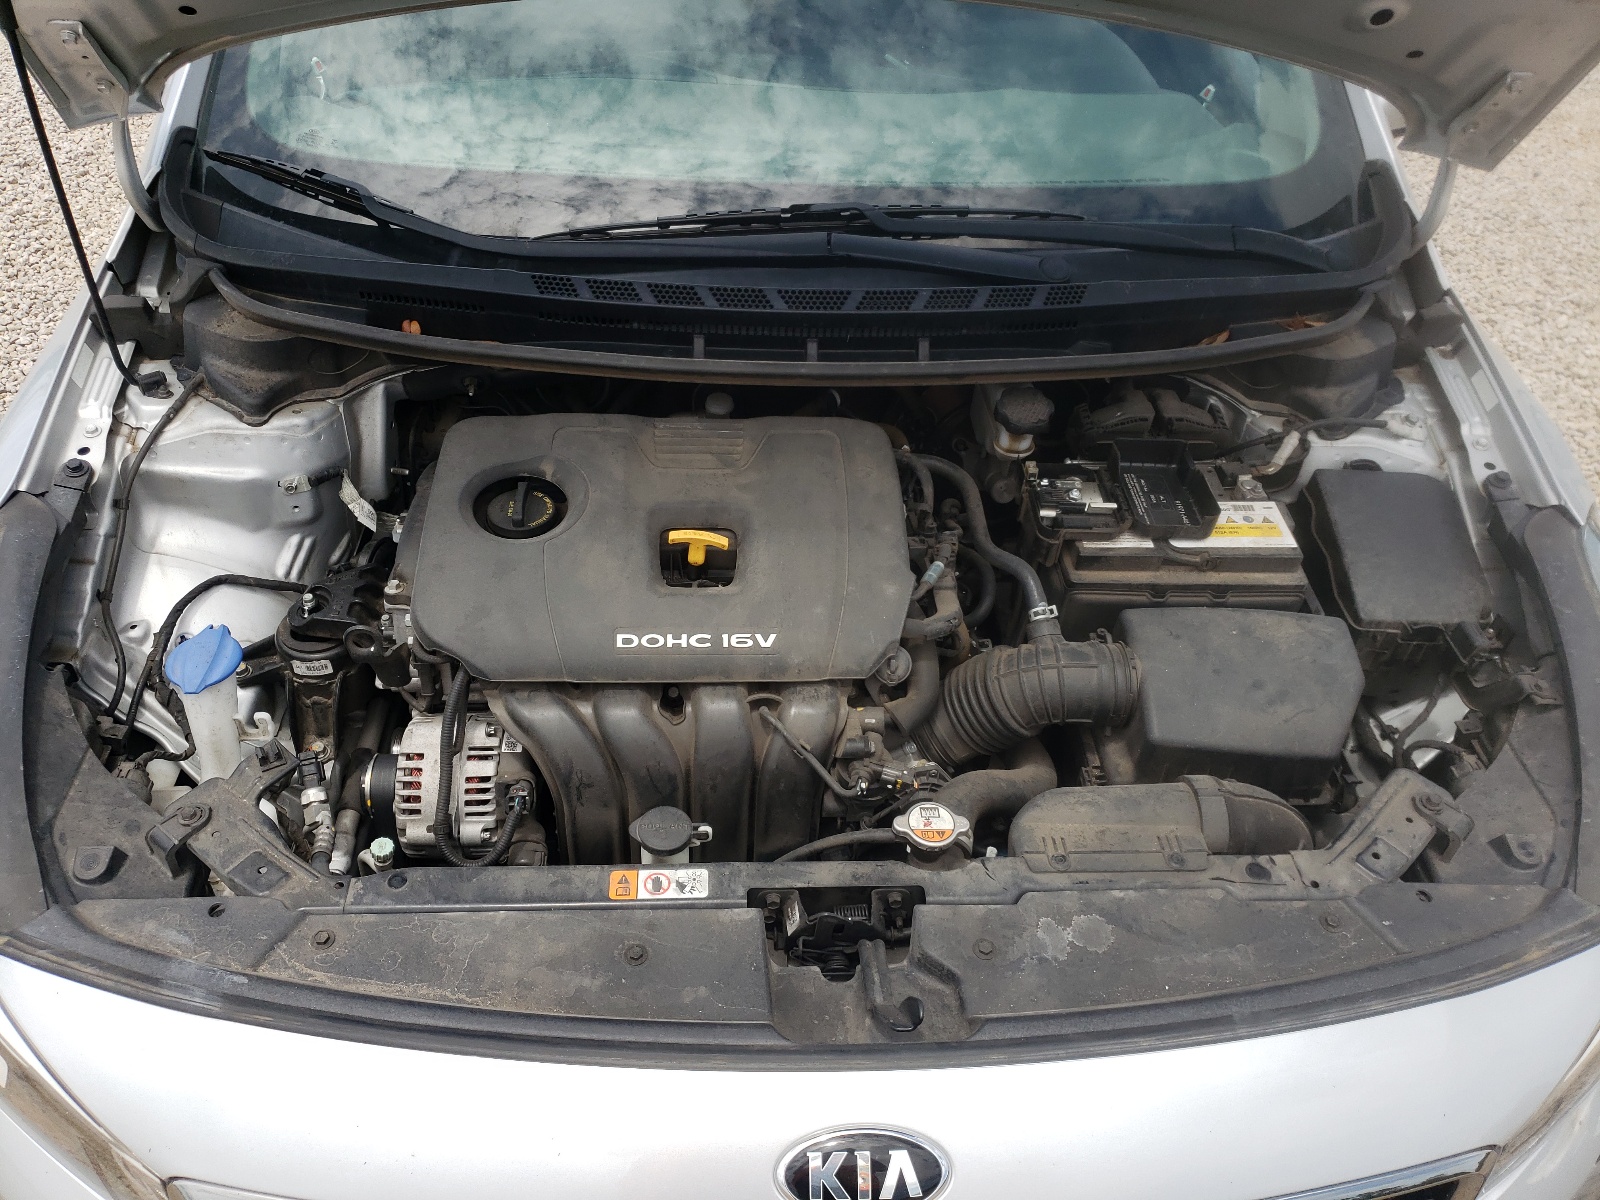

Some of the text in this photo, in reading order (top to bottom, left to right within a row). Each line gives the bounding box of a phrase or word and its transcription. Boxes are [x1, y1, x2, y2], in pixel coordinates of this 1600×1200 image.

[616, 633, 778, 648] DOHC 16V
[806, 1149, 923, 1200] KIA
